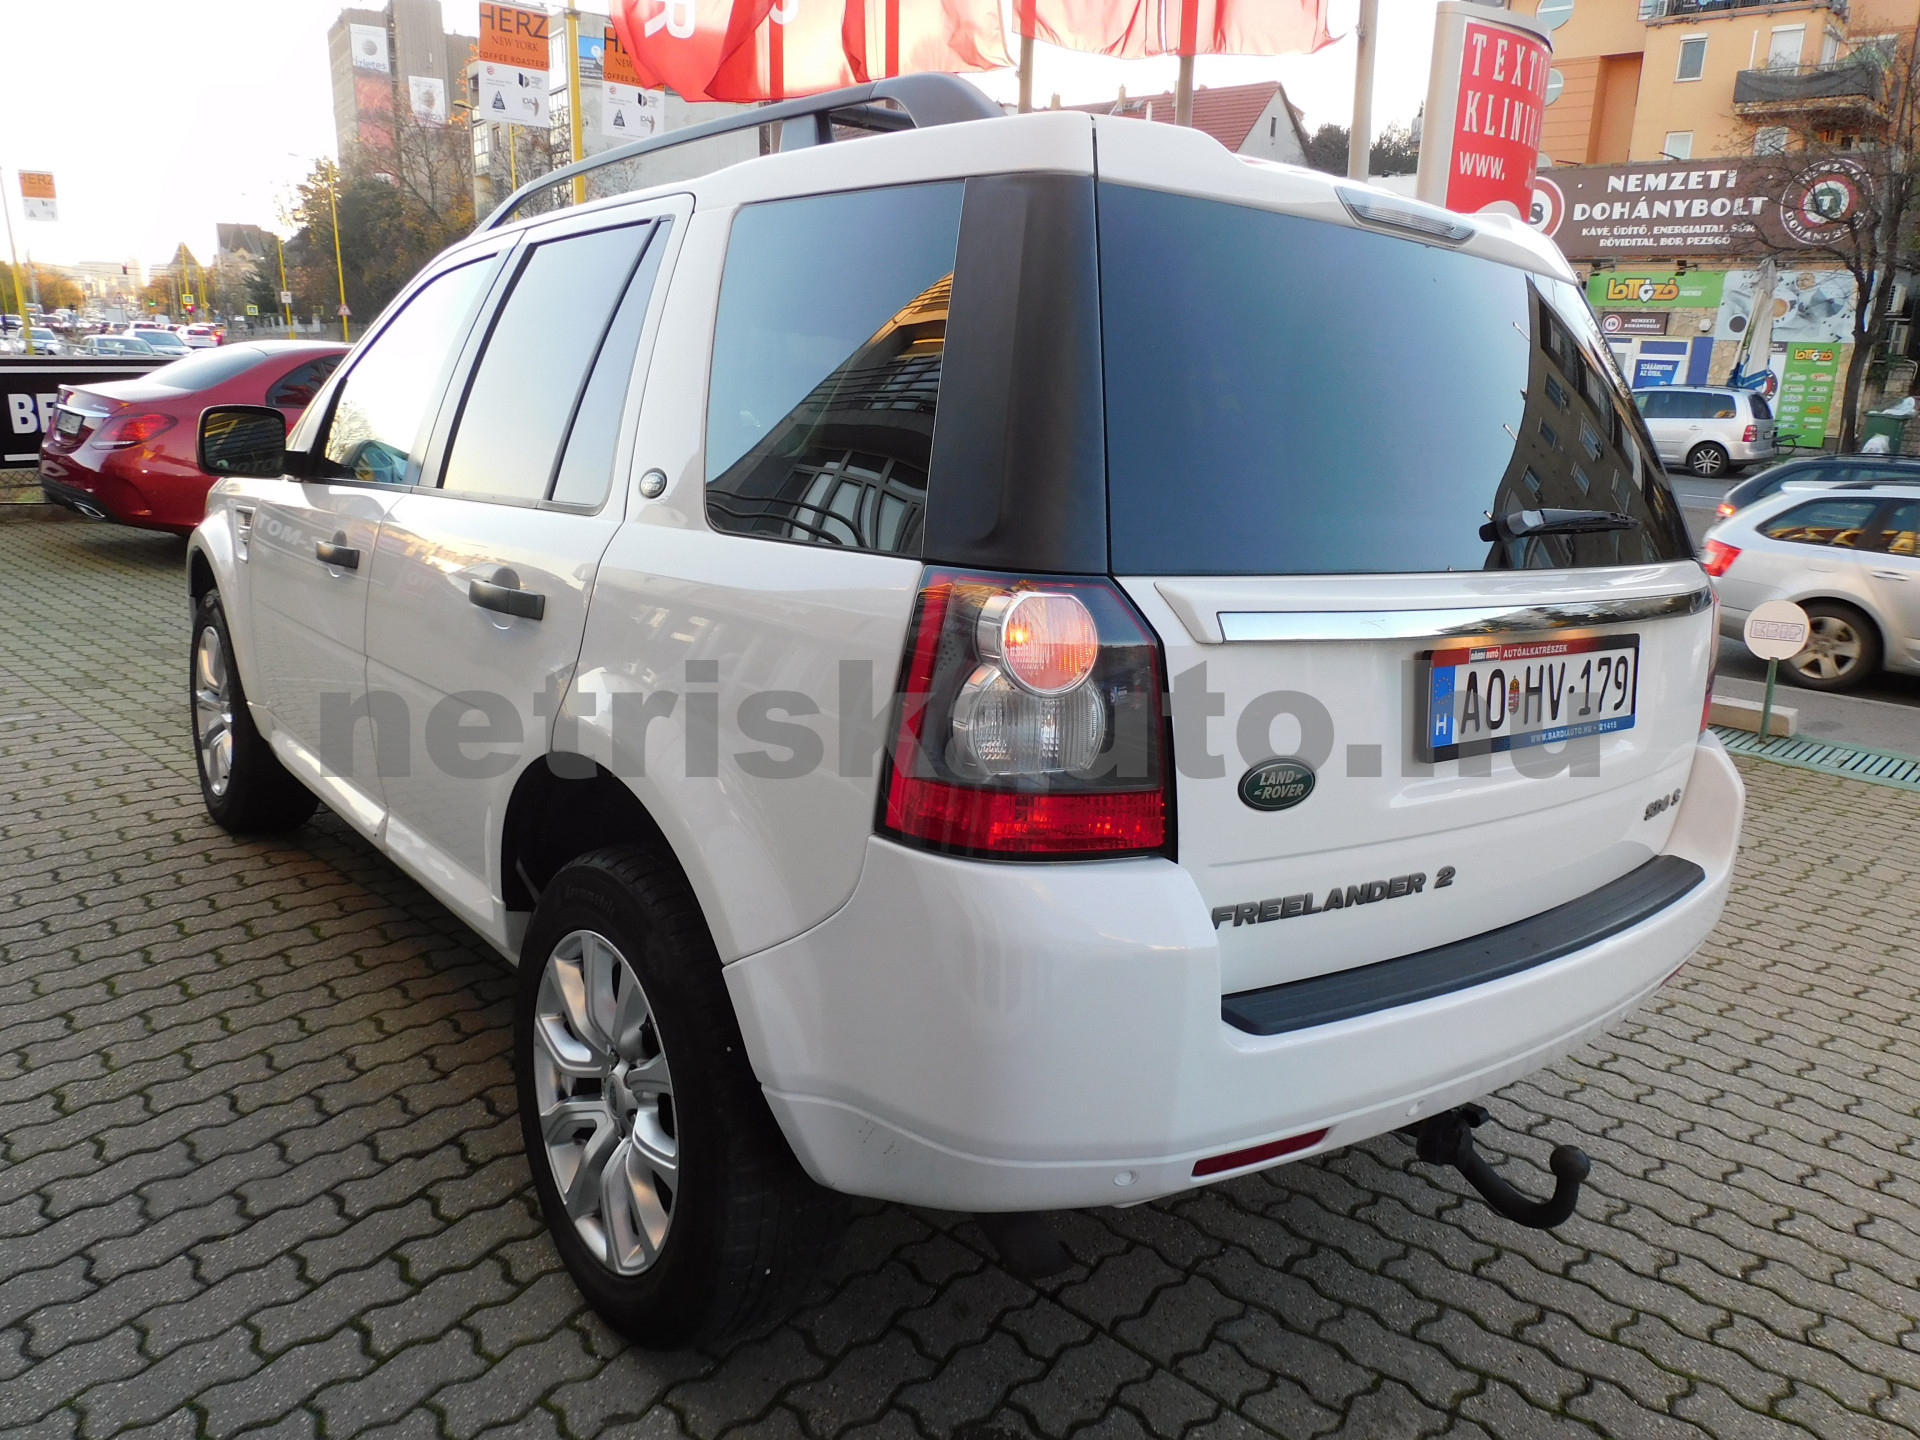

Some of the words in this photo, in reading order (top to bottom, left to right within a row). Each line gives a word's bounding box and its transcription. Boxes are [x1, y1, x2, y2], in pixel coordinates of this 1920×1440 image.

[479, 6, 549, 39] HERZ
[491, 35, 514, 48] NEW
[515, 39, 539, 52] YORK
[1607, 169, 1738, 193] NEMZETI
[1573, 196, 1769, 221] DOHÁNYBOLT
[1503, 644, 1568, 658] AUTÓALKATRÉSZEK
[1435, 713, 1447, 736] H
[1259, 770, 1296, 786] LAND
[1261, 783, 1305, 800] ROVER
[1211, 872, 1427, 930] FREELANDER
[1433, 865, 1456, 889] 2
